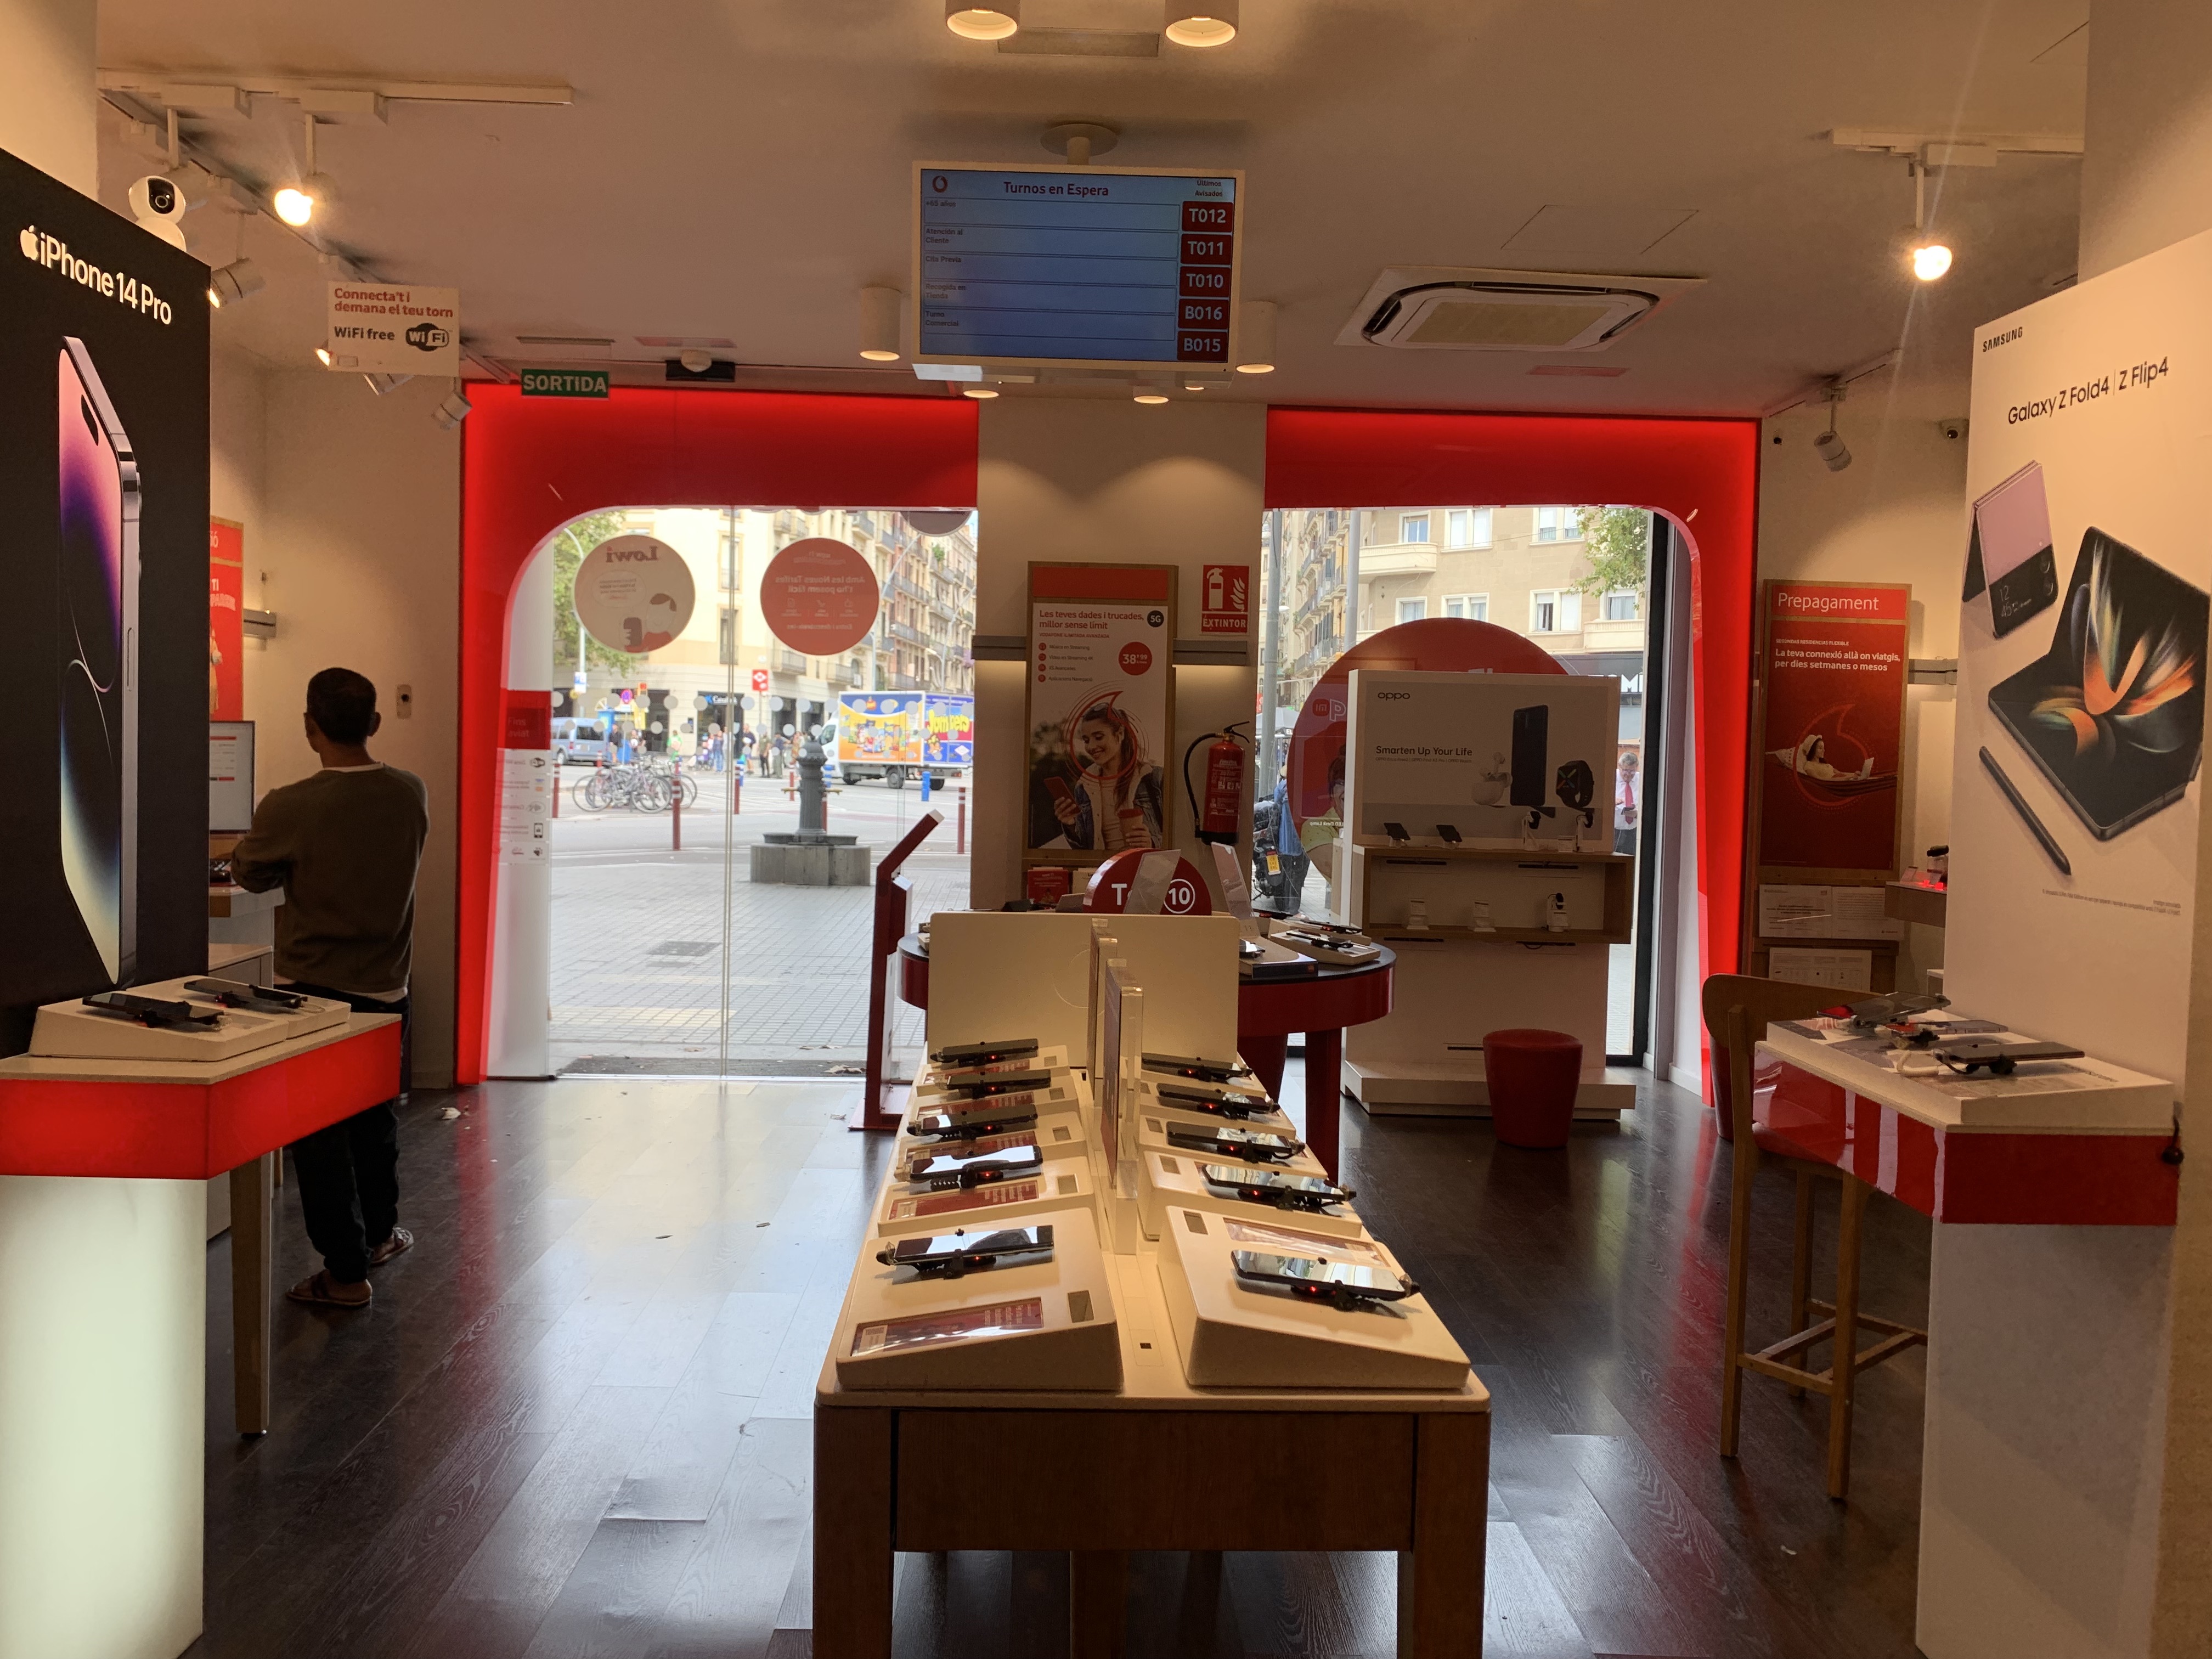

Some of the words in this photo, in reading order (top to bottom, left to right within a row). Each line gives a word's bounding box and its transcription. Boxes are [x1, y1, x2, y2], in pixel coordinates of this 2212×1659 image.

[1004, 181, 1045, 195] Turnos
[1048, 184, 1063, 195] en
[1067, 183, 1109, 198] Espera
[1188, 208, 1226, 223] T012
[1187, 241, 1223, 256] T011
[40, 232, 114, 297] iPhone
[116, 272, 138, 309] 14
[141, 283, 172, 325] Pro
[1186, 274, 1223, 289] T010
[334, 288, 403, 302] Connecta't
[405, 291, 410, 303] i
[334, 301, 386, 314] demana
[388, 303, 400, 315] el
[402, 306, 424, 317] teu
[426, 307, 453, 318] torn
[1184, 306, 1222, 320] B016
[367, 327, 396, 341] free
[1982, 326, 2023, 352] SAMSUNG
[1183, 338, 1221, 352] B015
[523, 373, 607, 393] SORTIDA
[2008, 396, 2057, 425] Galaxy
[2059, 390, 2067, 410] Z
[2070, 375, 2110, 407] Fold4
[2119, 370, 2128, 391] Z
[2131, 356, 2169, 388] Flip4
[1778, 592, 1879, 612] Prepagament
[1039, 610, 1054, 618] Les
[1055, 611, 1077, 619] teves
[1078, 610, 1102, 619] dades
[1103, 611, 1107, 619] i
[1107, 612, 1144, 621] trucades,
[1149, 614, 1161, 623] 5G
[1203, 617, 1246, 629] EXTINTOR
[1039, 620, 1063, 629] millor
[1086, 620, 1108, 630] límit
[1775, 648, 1786, 657] La
[1805, 650, 1843, 659] connexió
[1843, 650, 1859, 659] allà
[1872, 652, 1900, 663] viatgis,
[1775, 660, 1790, 669] per
[1790, 660, 1808, 668] dies
[1809, 661, 1851, 670] setmanes
[1859, 663, 1888, 672] mesos
[1378, 691, 1410, 701] oppo
[1375, 746, 1415, 755] Smarten
[1417, 746, 1430, 757] Up
[1432, 746, 1453, 756] Your
[1455, 746, 1473, 756] Life
[1167, 887, 1190, 906] 10
